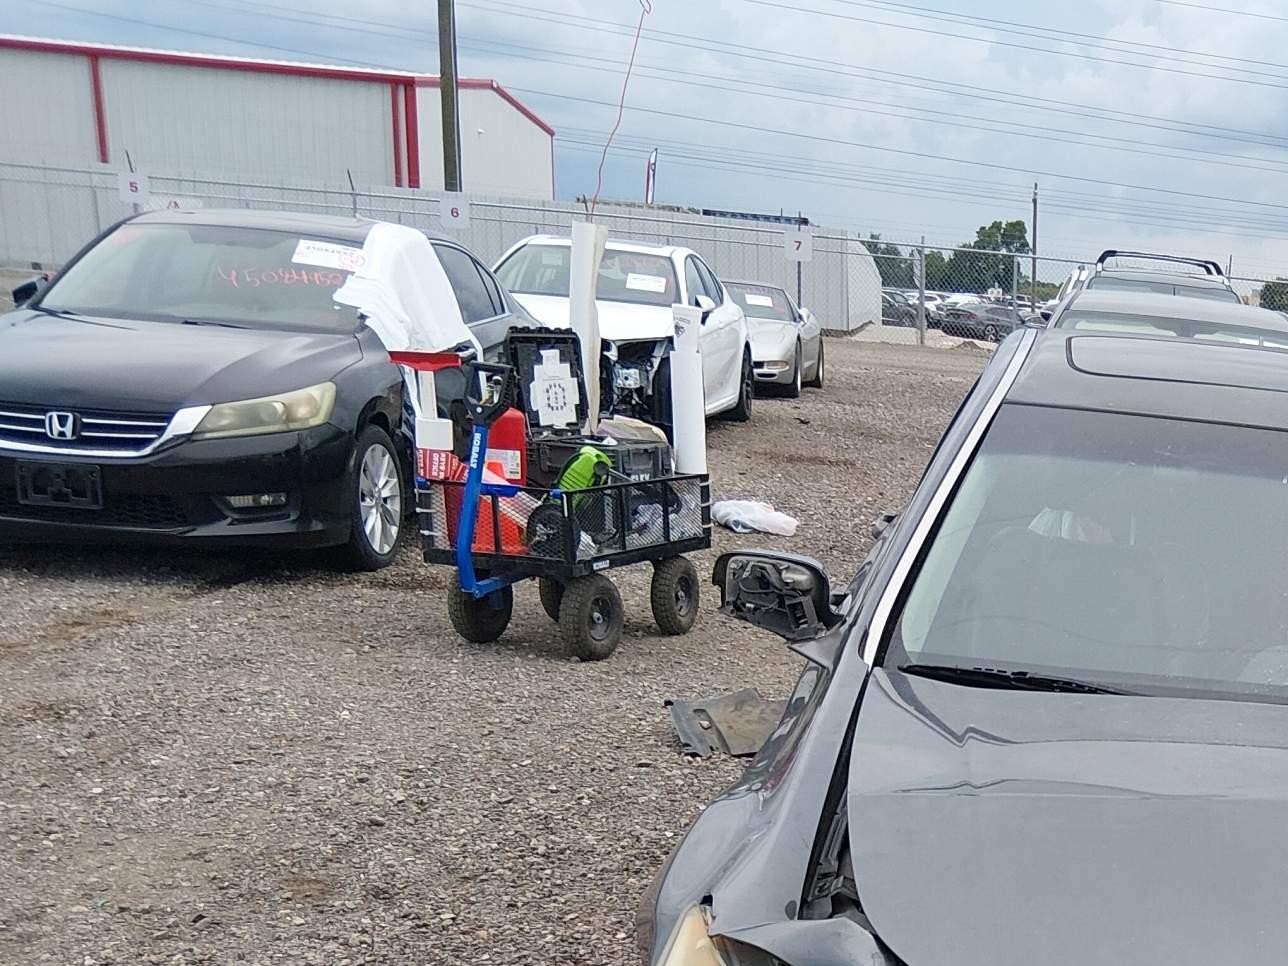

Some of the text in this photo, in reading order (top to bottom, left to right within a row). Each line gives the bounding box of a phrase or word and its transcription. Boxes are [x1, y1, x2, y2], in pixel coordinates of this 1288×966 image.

[128, 180, 139, 193] 5
[450, 207, 460, 219] 6
[793, 240, 803, 252] 7
[470, 432, 482, 470] KOBALT
[431, 452, 439, 477] OFFICE
